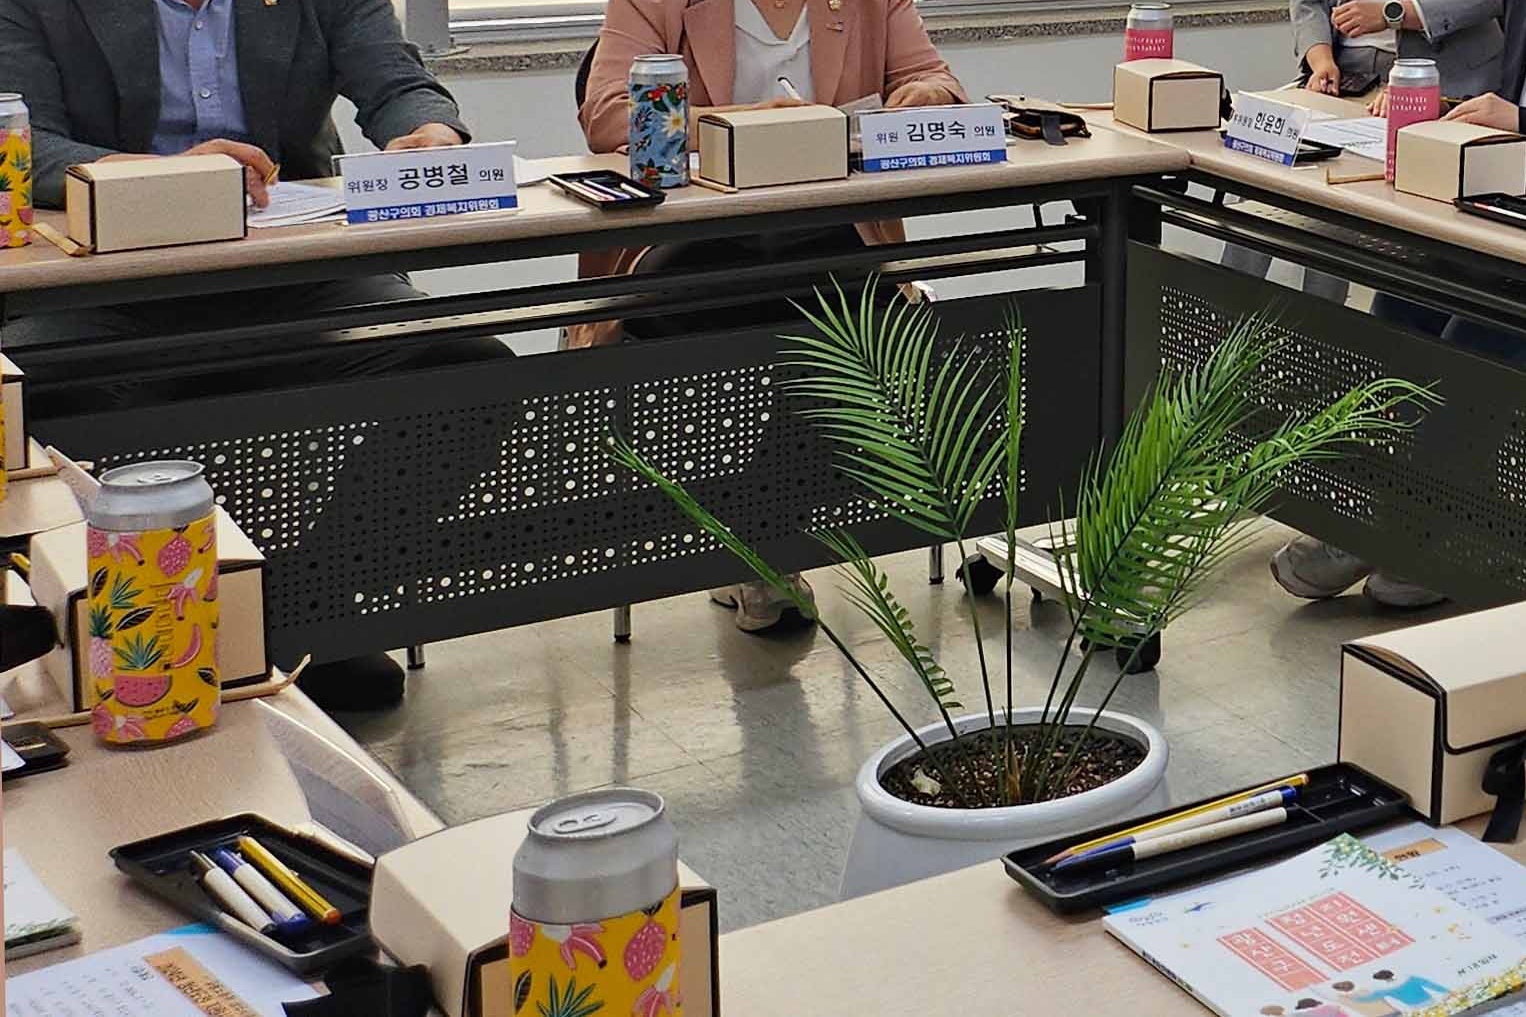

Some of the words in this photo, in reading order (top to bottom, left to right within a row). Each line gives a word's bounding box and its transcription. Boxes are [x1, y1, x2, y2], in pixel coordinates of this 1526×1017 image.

[906, 121, 966, 143] 김명숙
[974, 125, 996, 138] 의원
[347, 178, 388, 195] 위원장
[398, 163, 469, 191] 공병철
[479, 168, 505, 182] 의원
